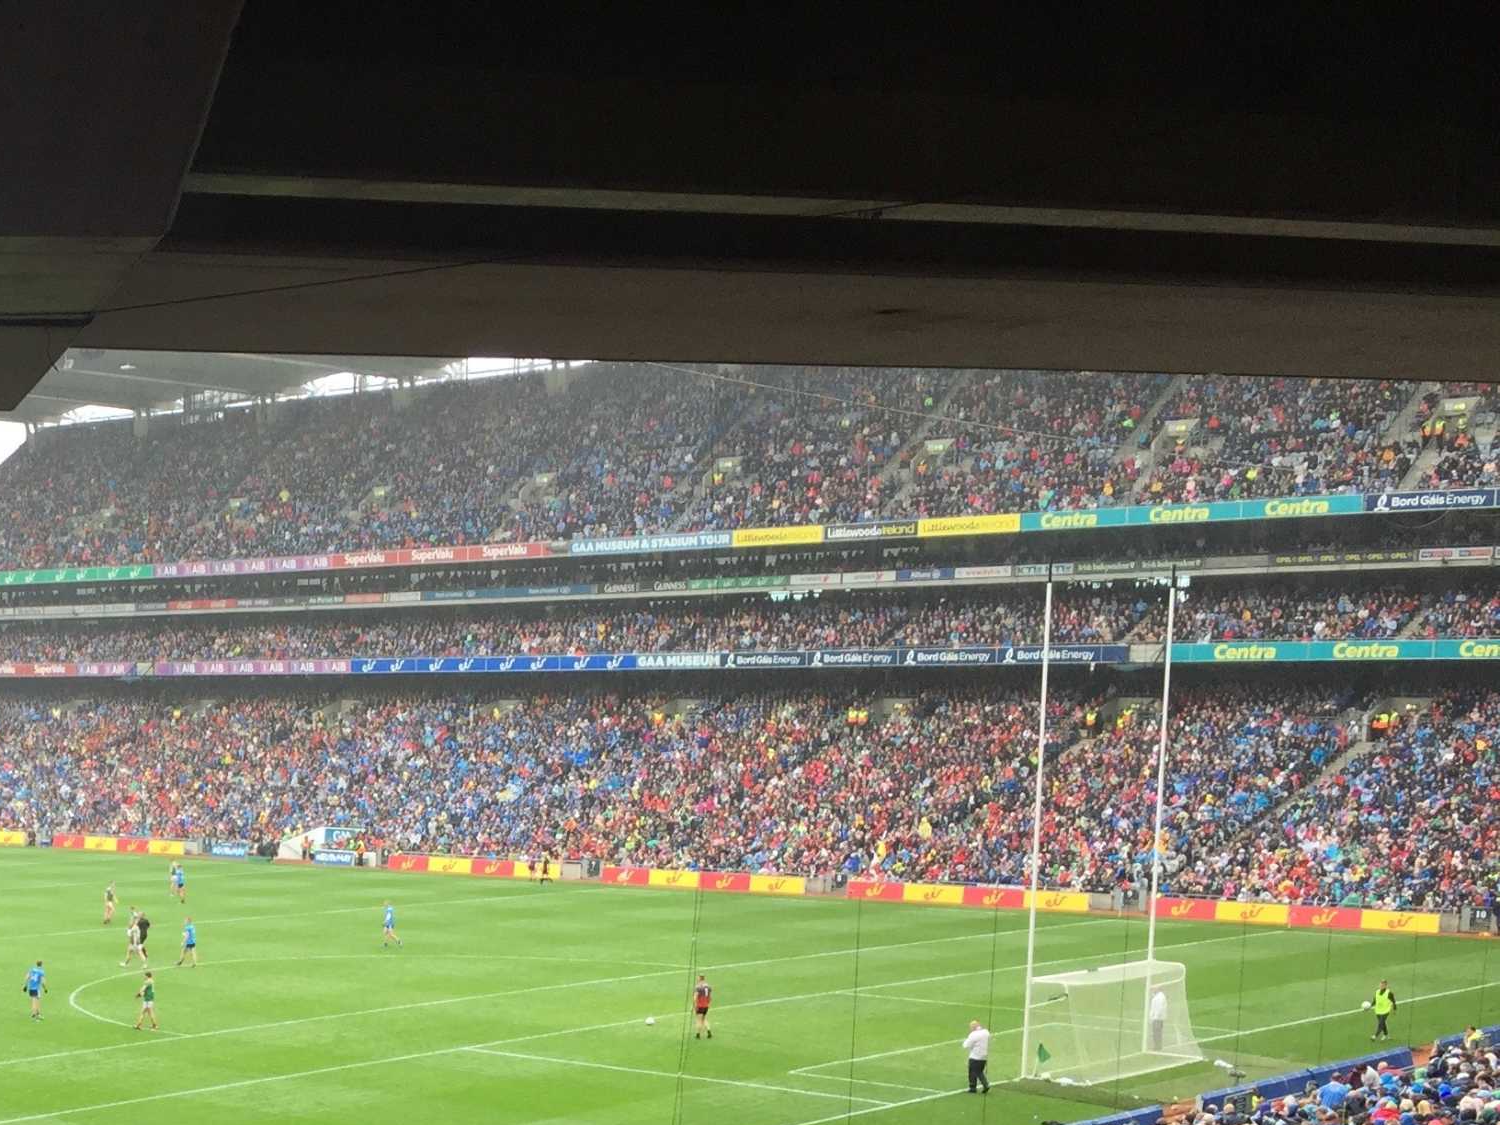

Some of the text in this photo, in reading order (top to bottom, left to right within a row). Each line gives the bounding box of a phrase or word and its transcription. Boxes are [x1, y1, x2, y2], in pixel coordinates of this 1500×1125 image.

[1391, 496, 1419, 508] Bord
[1446, 492, 1487, 506] Energy
[1150, 506, 1210, 523] Centra
[1264, 500, 1329, 517] Centra
[1041, 512, 1098, 529] Centra
[572, 532, 731, 553] GAA MUSEUM & STADIUM TOUR
[411, 549, 454, 563] SuperValu
[483, 543, 528, 560] SuperValu
[344, 553, 384, 567] SuperValu
[823, 651, 843, 662] Bord
[863, 651, 893, 663] Energy
[917, 650, 939, 662] Bord
[959, 650, 991, 663] Energy
[1017, 649, 1039, 660] Bord
[1062, 649, 1095, 661] Energy
[1214, 643, 1277, 660] Centra
[1333, 642, 1399, 659] Centra
[638, 656, 721, 667] GAA MUSEUM
[736, 654, 756, 665] Bord
[773, 654, 801, 665] Energy
[1475, 909, 1488, 919] 10
